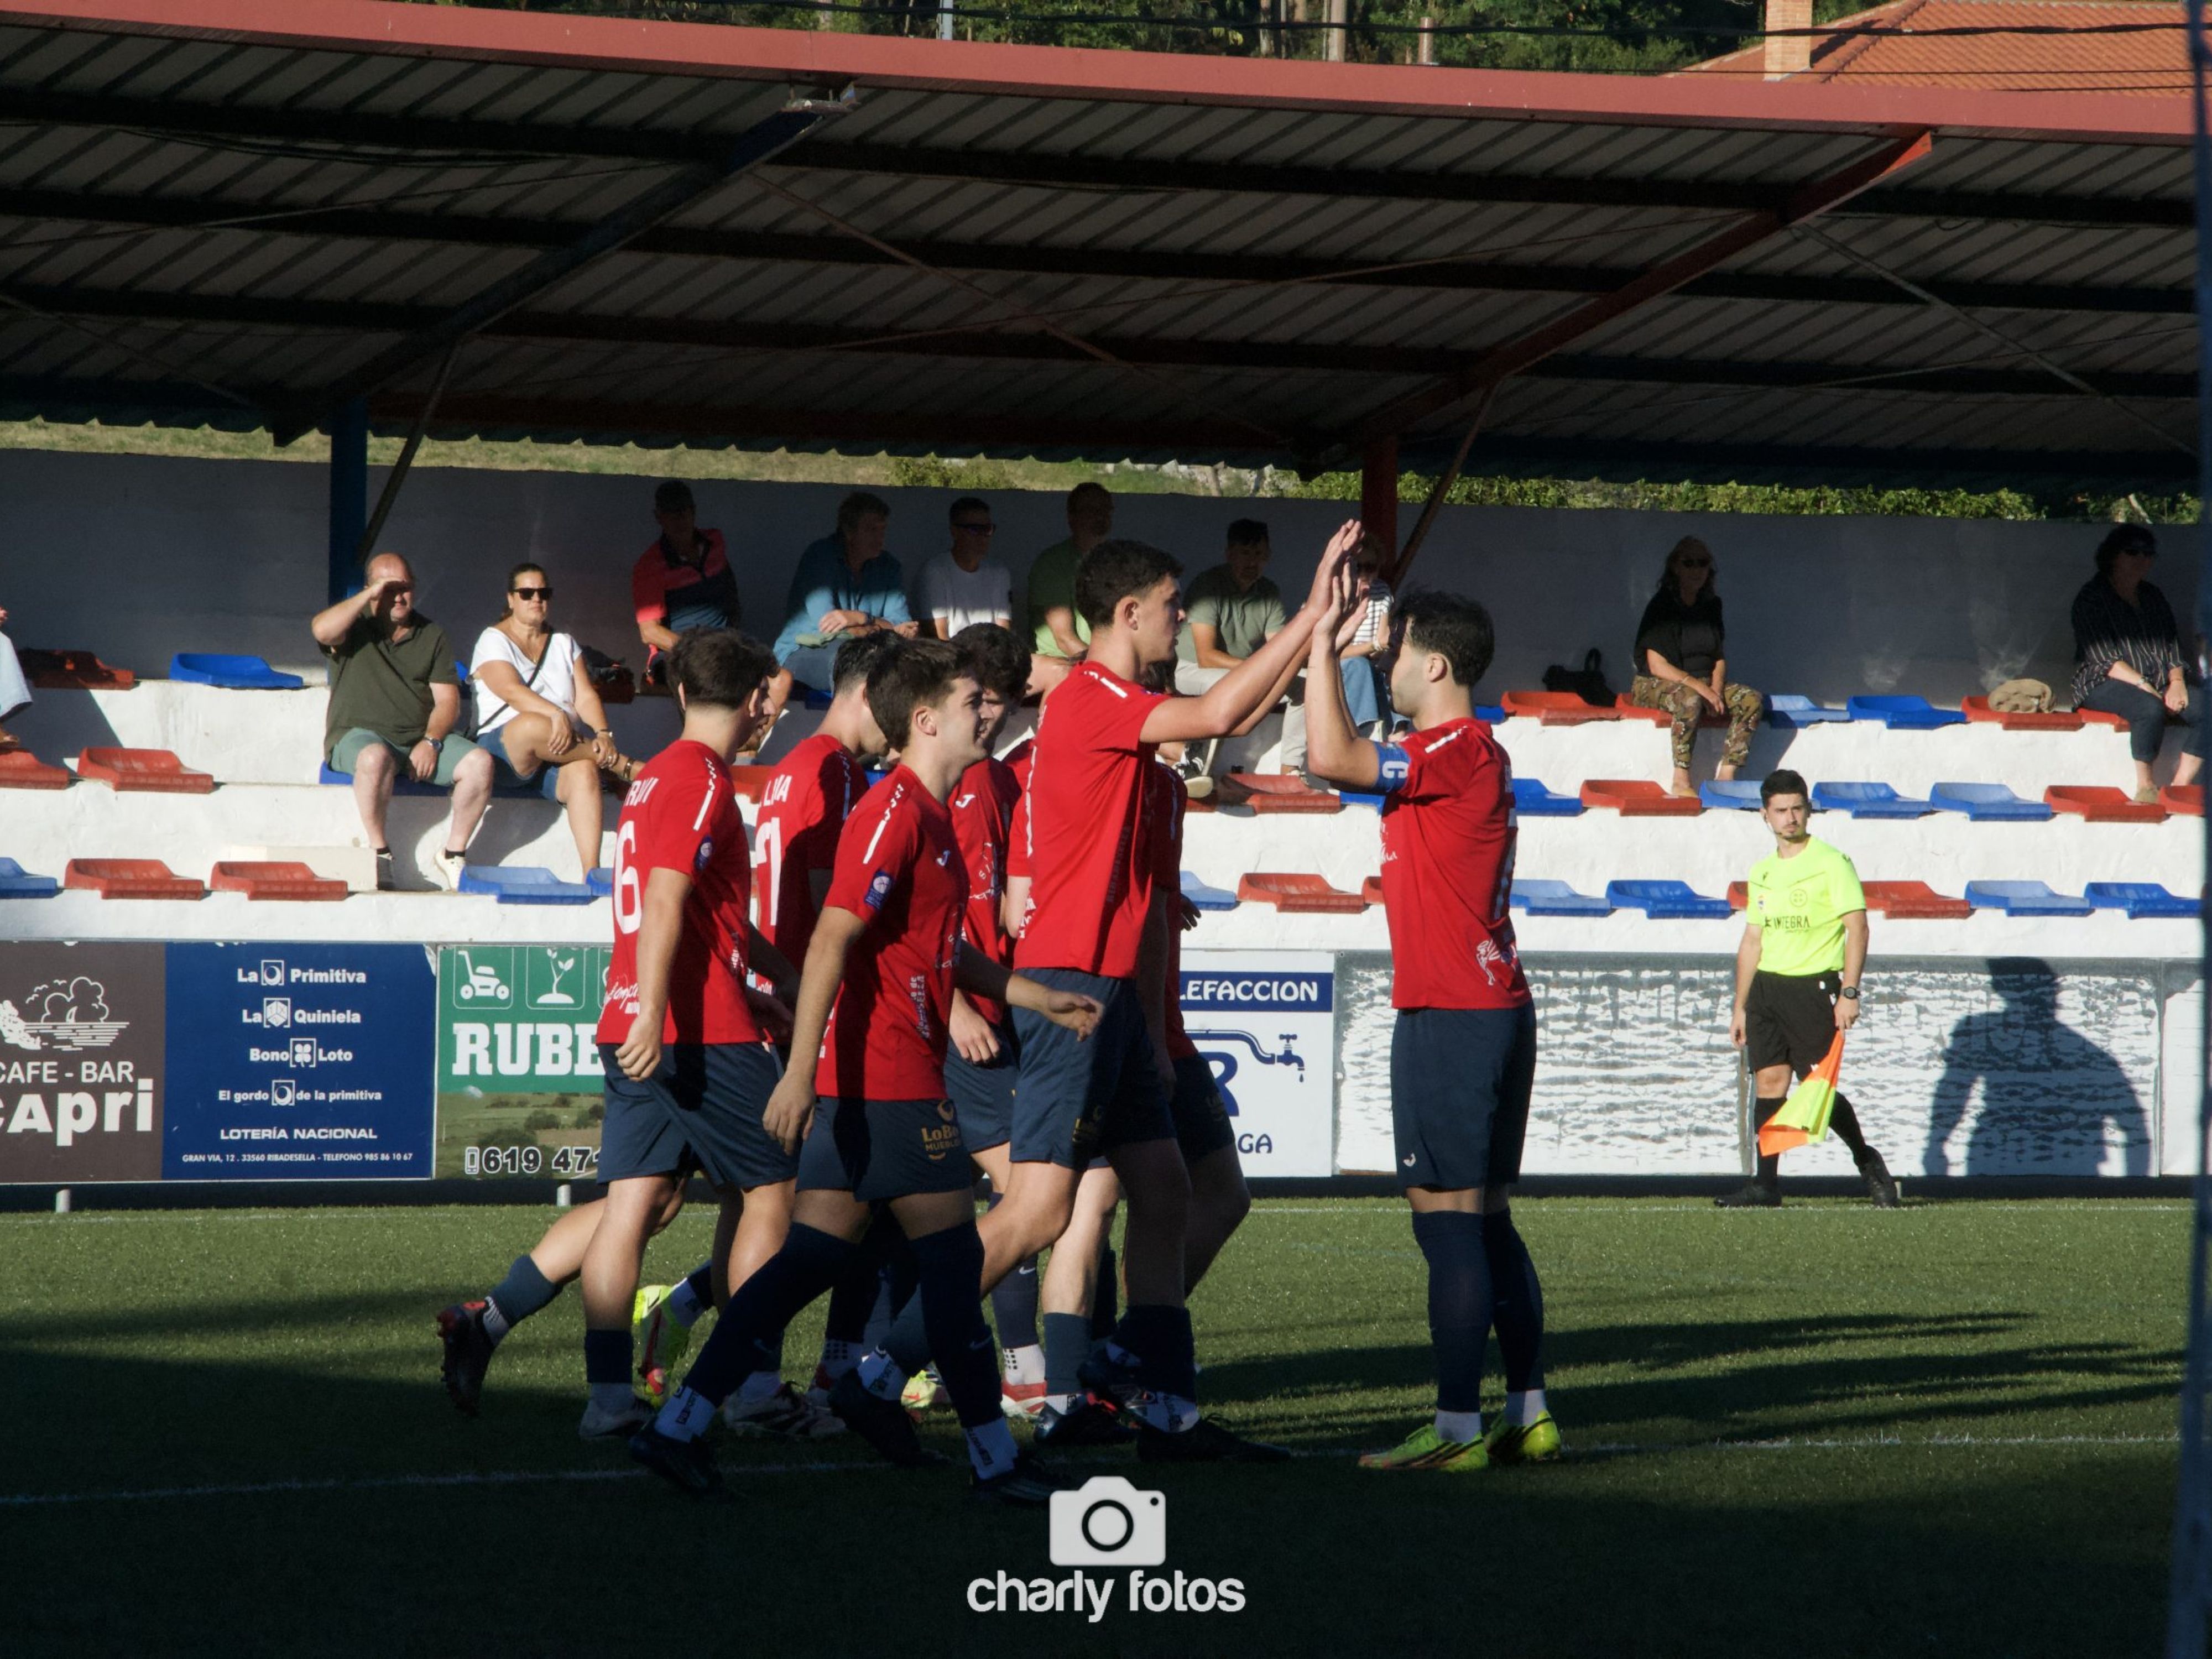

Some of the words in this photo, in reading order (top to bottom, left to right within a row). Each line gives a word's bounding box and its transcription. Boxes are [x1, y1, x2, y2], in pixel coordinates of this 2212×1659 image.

[614, 820, 642, 935] 6
[237, 968, 259, 982] La
[290, 968, 367, 983] Primitiva
[1180, 979, 1318, 1003] EFACCION
[242, 1009, 263, 1023] La
[294, 1009, 362, 1024] Quiniela
[250, 1048, 290, 1062] Bono
[318, 1048, 353, 1062] Loto
[81, 1061, 134, 1083] BAR
[218, 1090, 230, 1100] El
[234, 1090, 269, 1103] gordo
[296, 1090, 311, 1100] de
[315, 1090, 325, 1100] la
[328, 1090, 382, 1102] primitiva
[0, 1078, 154, 1146] Apri
[221, 1126, 289, 1140] LOTERÍA
[294, 1128, 377, 1139] NACIONAL
[1238, 1134, 1272, 1154] GA
[482, 1147, 542, 1173] 619
